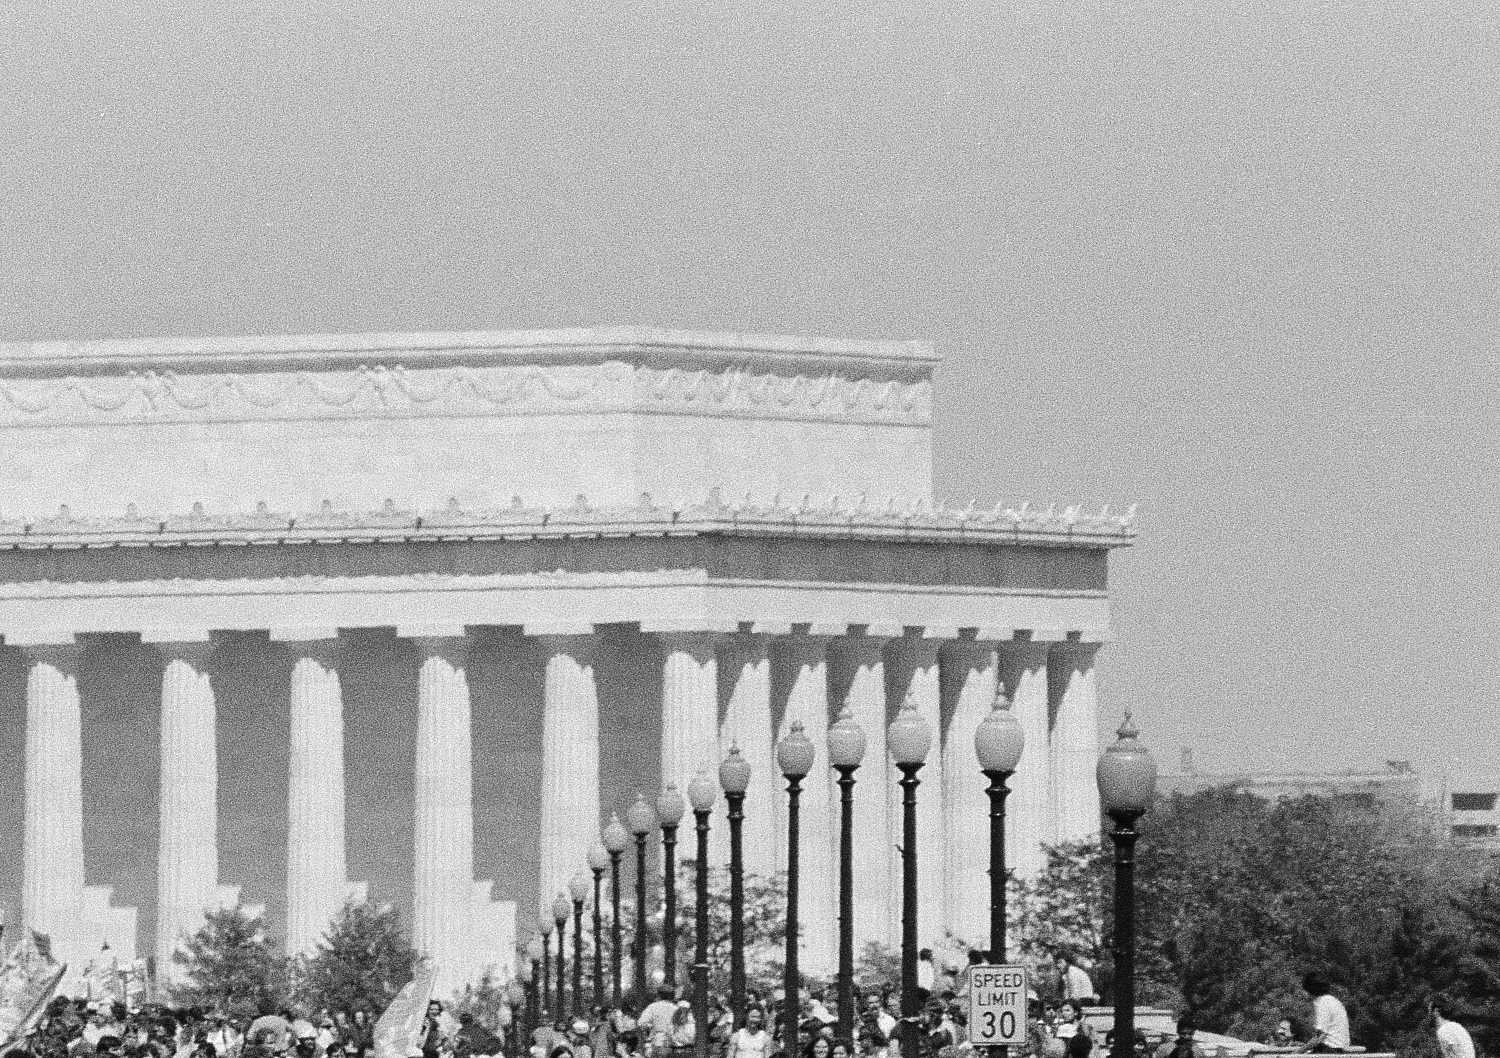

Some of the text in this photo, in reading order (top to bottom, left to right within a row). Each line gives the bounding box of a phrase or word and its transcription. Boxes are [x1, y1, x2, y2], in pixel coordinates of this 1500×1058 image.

[974, 973, 1024, 989] SPEED
[978, 991, 1018, 1007] LIMIT
[981, 1010, 1016, 1040] 30
